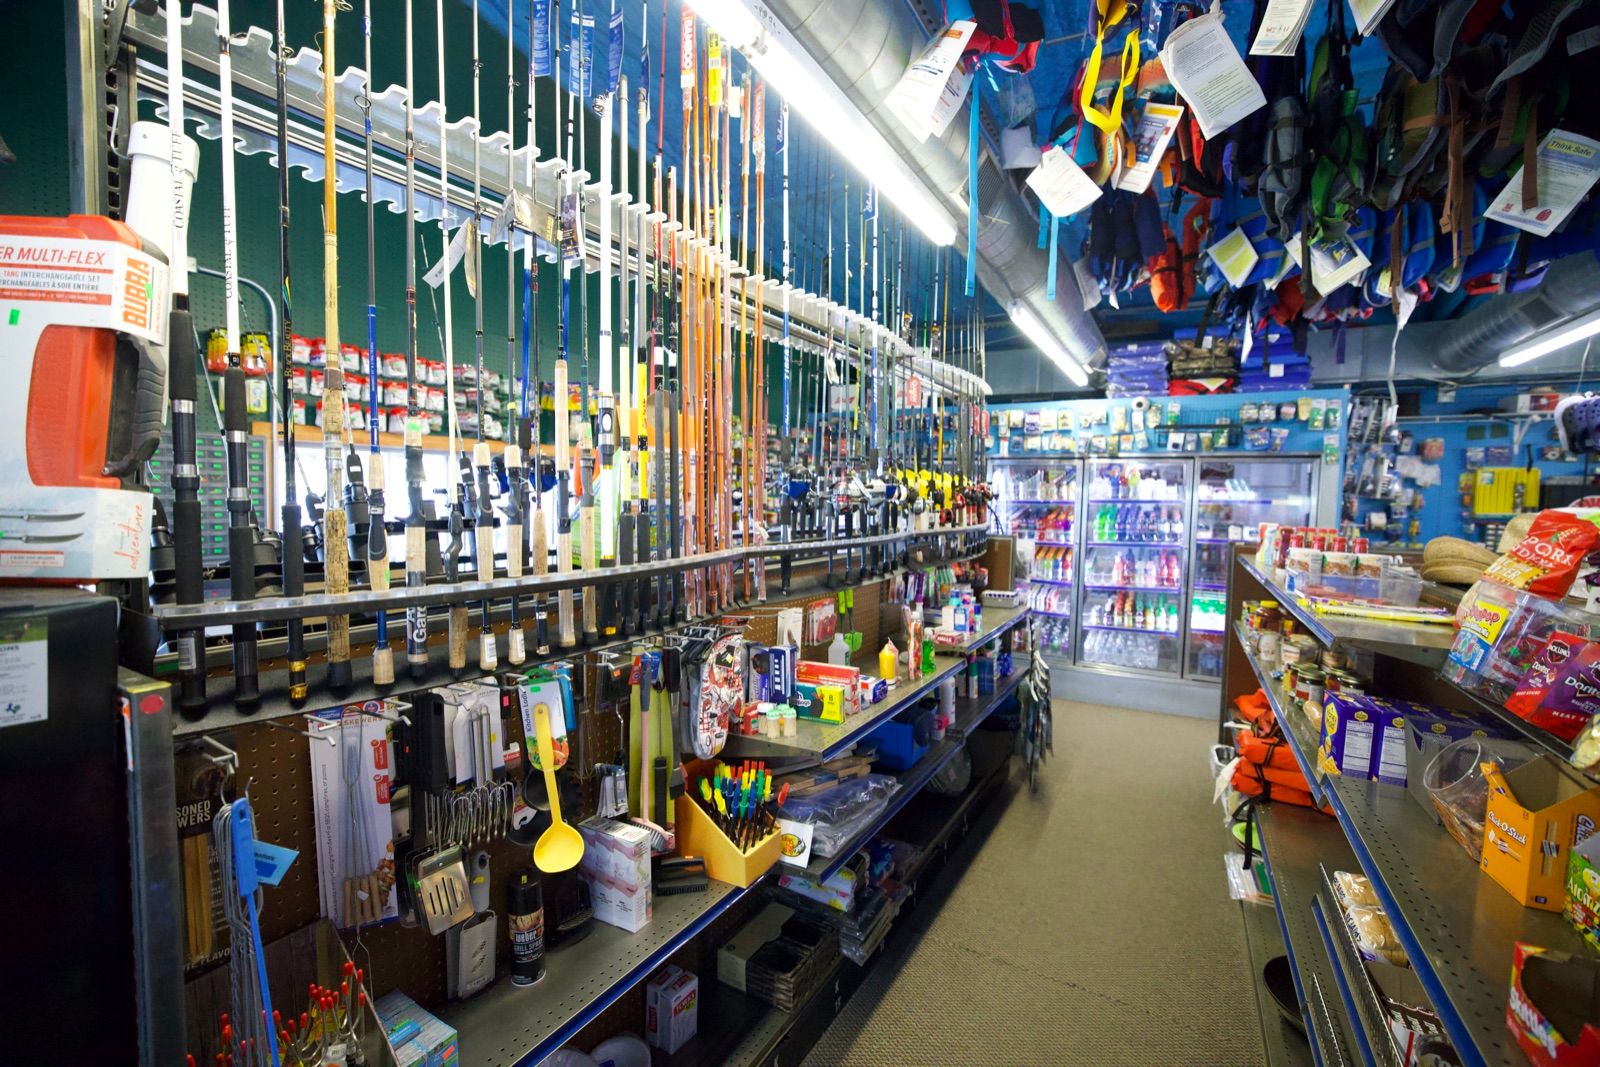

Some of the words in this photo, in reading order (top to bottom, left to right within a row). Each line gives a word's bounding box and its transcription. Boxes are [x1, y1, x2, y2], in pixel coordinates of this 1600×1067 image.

[1551, 140, 1572, 151] Think
[1572, 145, 1592, 156] Safe
[17, 247, 106, 266] MULTI-FLEX
[20, 271, 87, 282] INTERCHANGEABLE
[87, 274, 101, 282] SET
[122, 256, 151, 330] BUBBA
[524, 709, 532, 732] Kitchen
